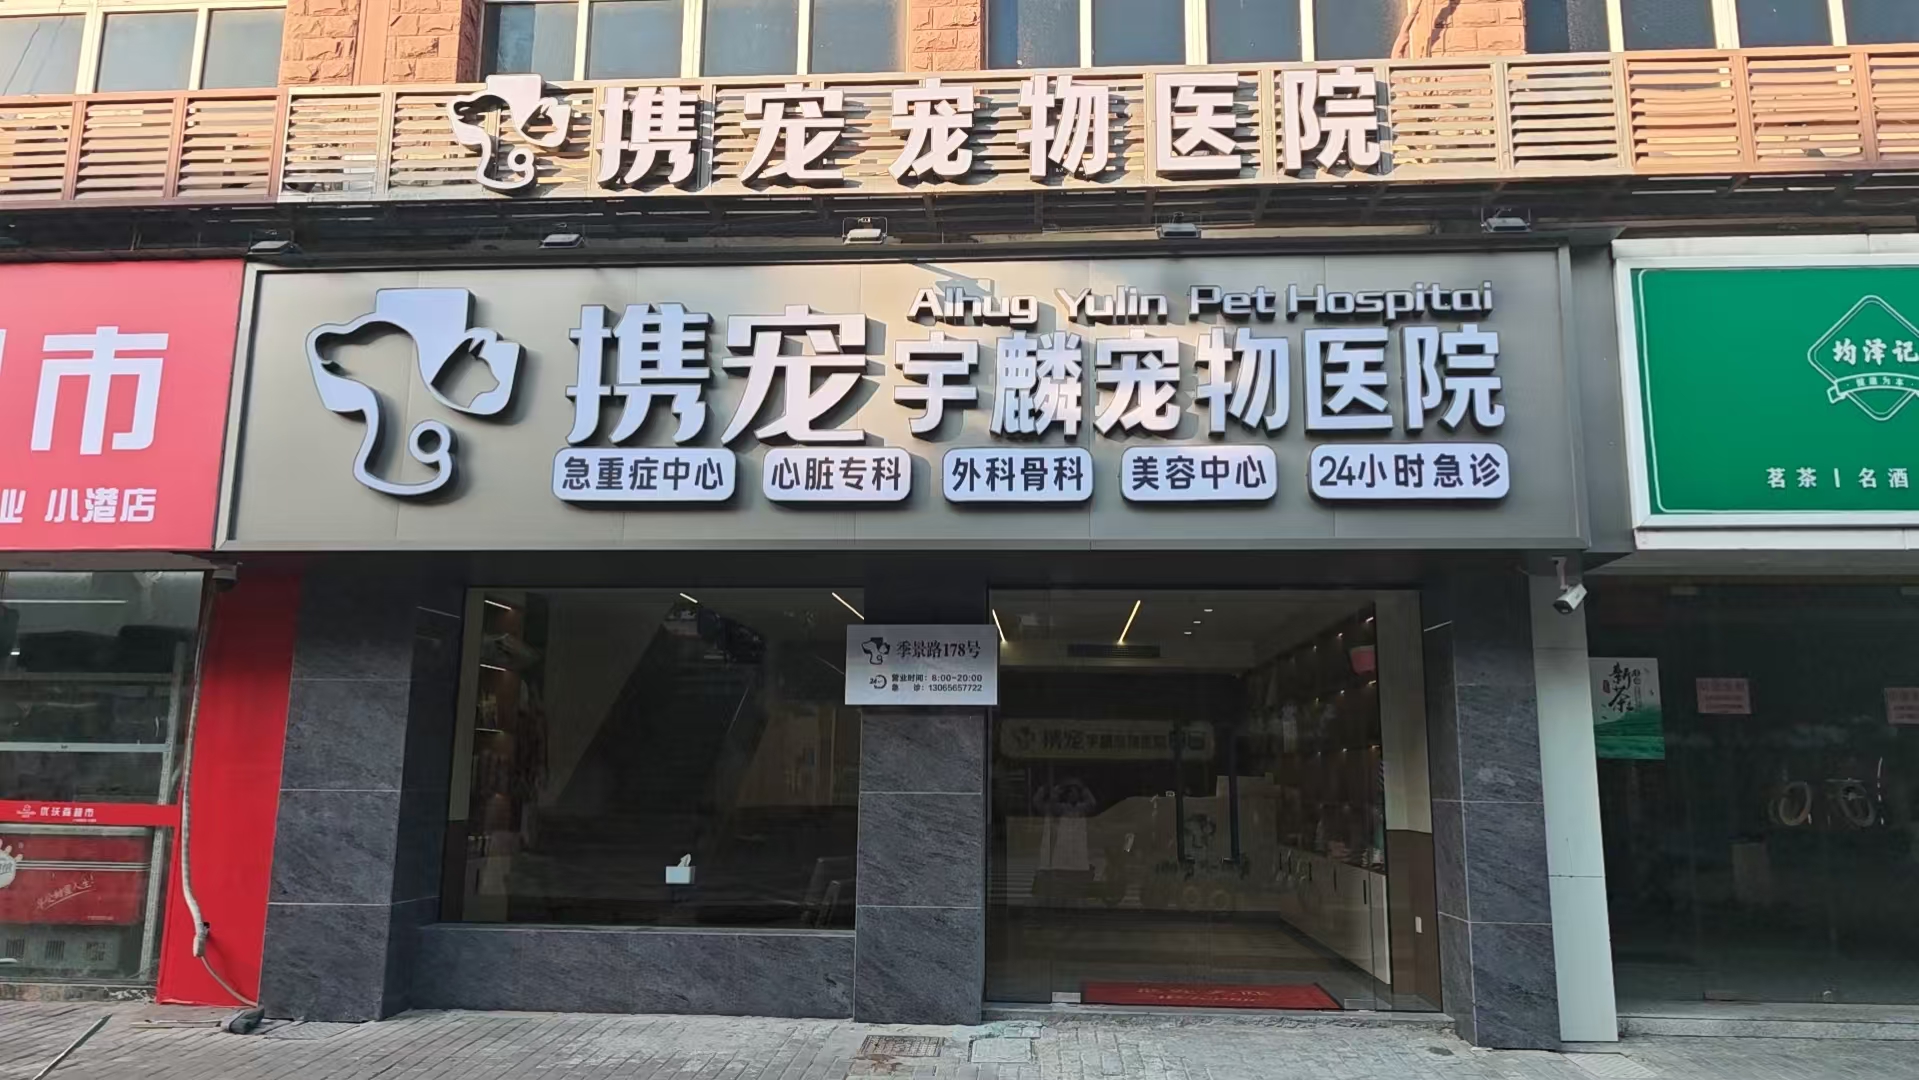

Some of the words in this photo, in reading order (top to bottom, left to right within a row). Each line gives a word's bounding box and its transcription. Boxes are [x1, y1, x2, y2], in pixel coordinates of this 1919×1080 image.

[597, 67, 1382, 187] 携宠宠物医院
[1054, 285, 1168, 325] Yulin
[1188, 284, 1276, 320] Pet
[1832, 338, 1919, 366] 均泽记
[0, 325, 169, 455] 市
[562, 456, 724, 491] 急重症中心
[771, 456, 901, 491] 心脏专科
[951, 456, 1084, 492] 外科骨科
[1130, 455, 1268, 491] 美容中心
[1318, 452, 1501, 489] 24小时急诊
[44, 488, 157, 523] 小港店
[896, 640, 982, 659] 季景路178号
